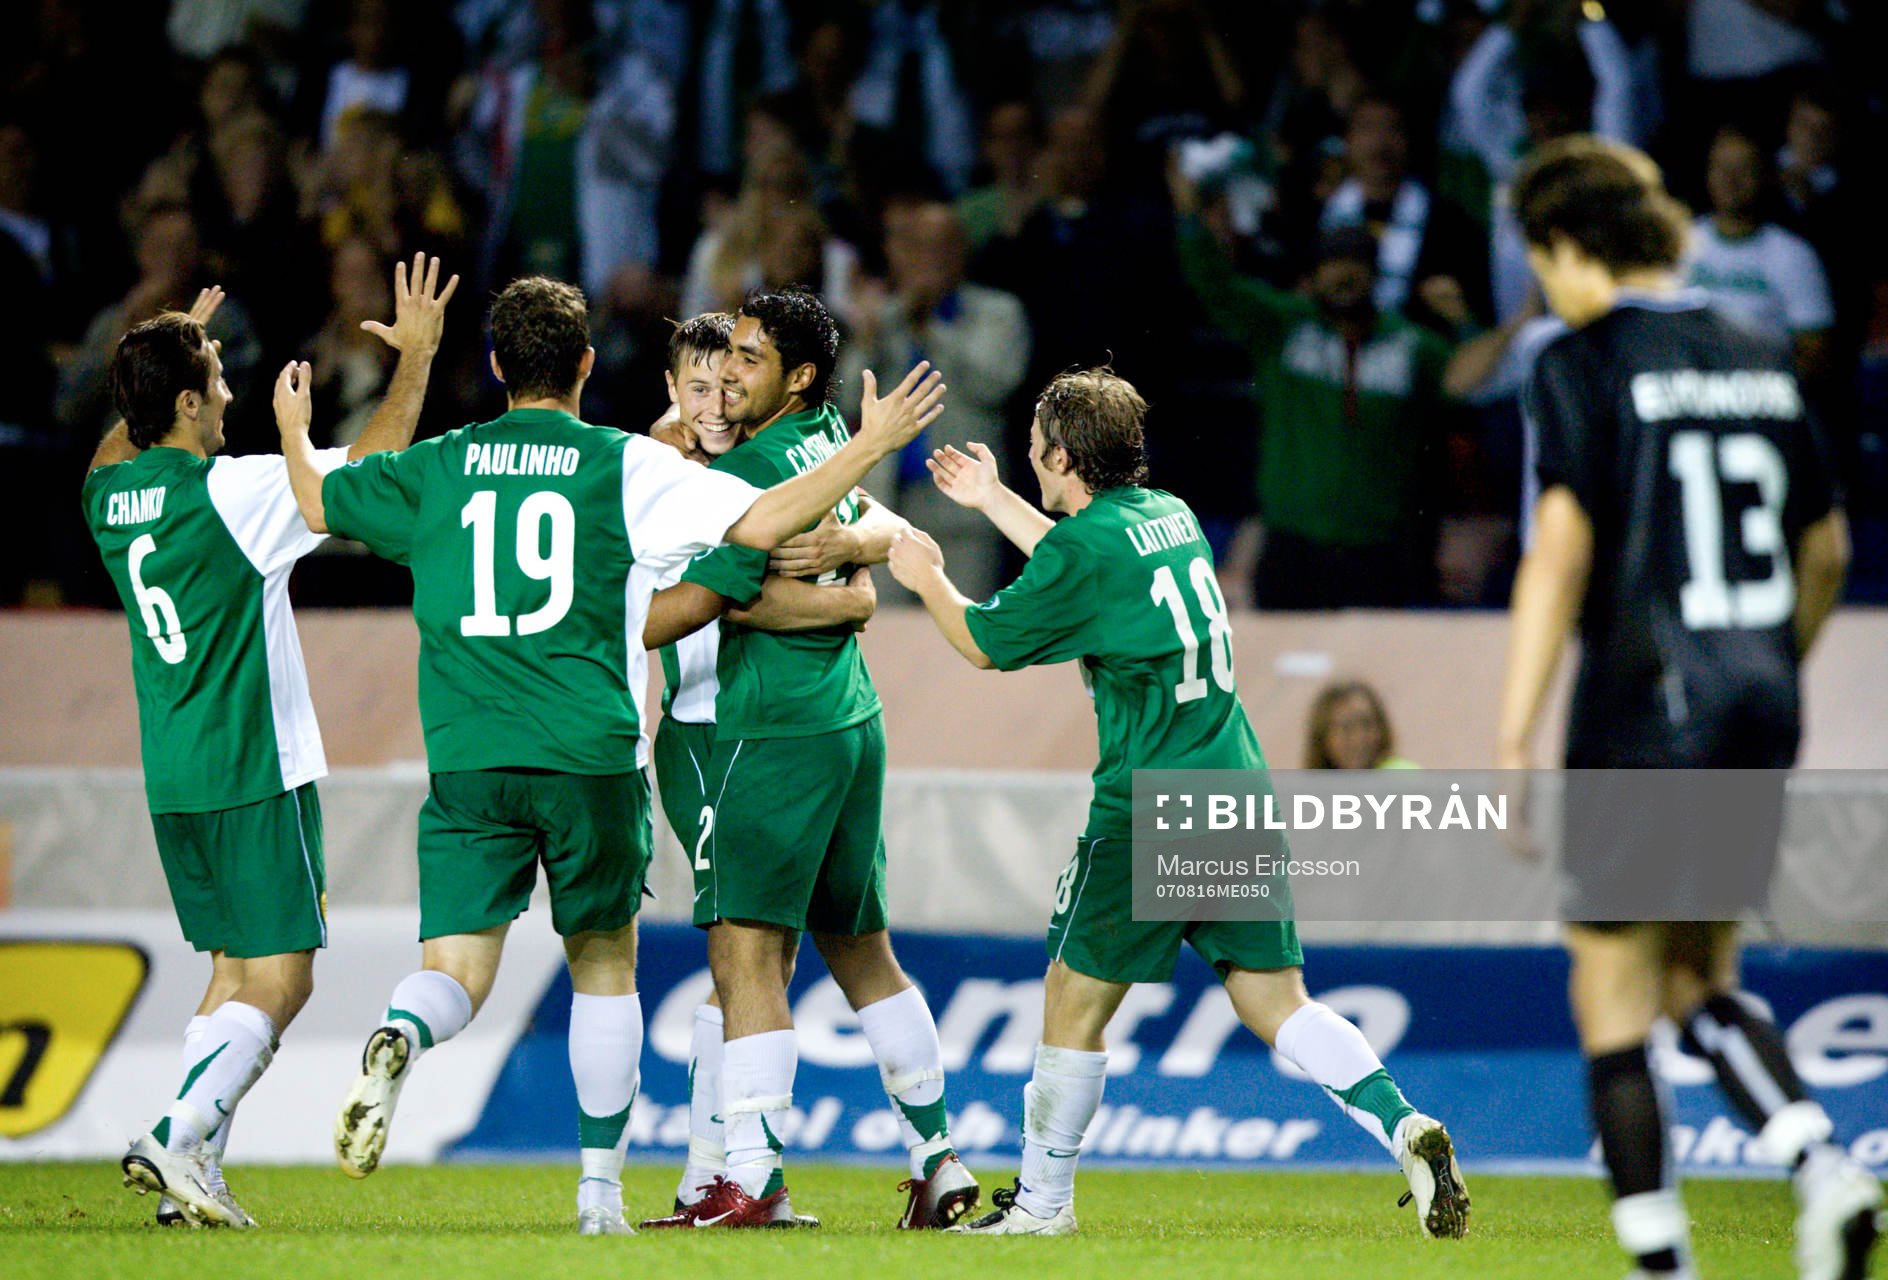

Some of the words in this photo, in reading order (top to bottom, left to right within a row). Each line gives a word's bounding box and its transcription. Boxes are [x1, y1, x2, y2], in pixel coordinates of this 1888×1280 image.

[107, 486, 166, 526] CHANKO
[464, 443, 580, 476] PAULINHO
[460, 490, 576, 637] 19
[1125, 511, 1199, 557] LAITINEN
[1668, 430, 1796, 631] 13
[128, 533, 187, 664] 6
[1150, 556, 1234, 704] 18
